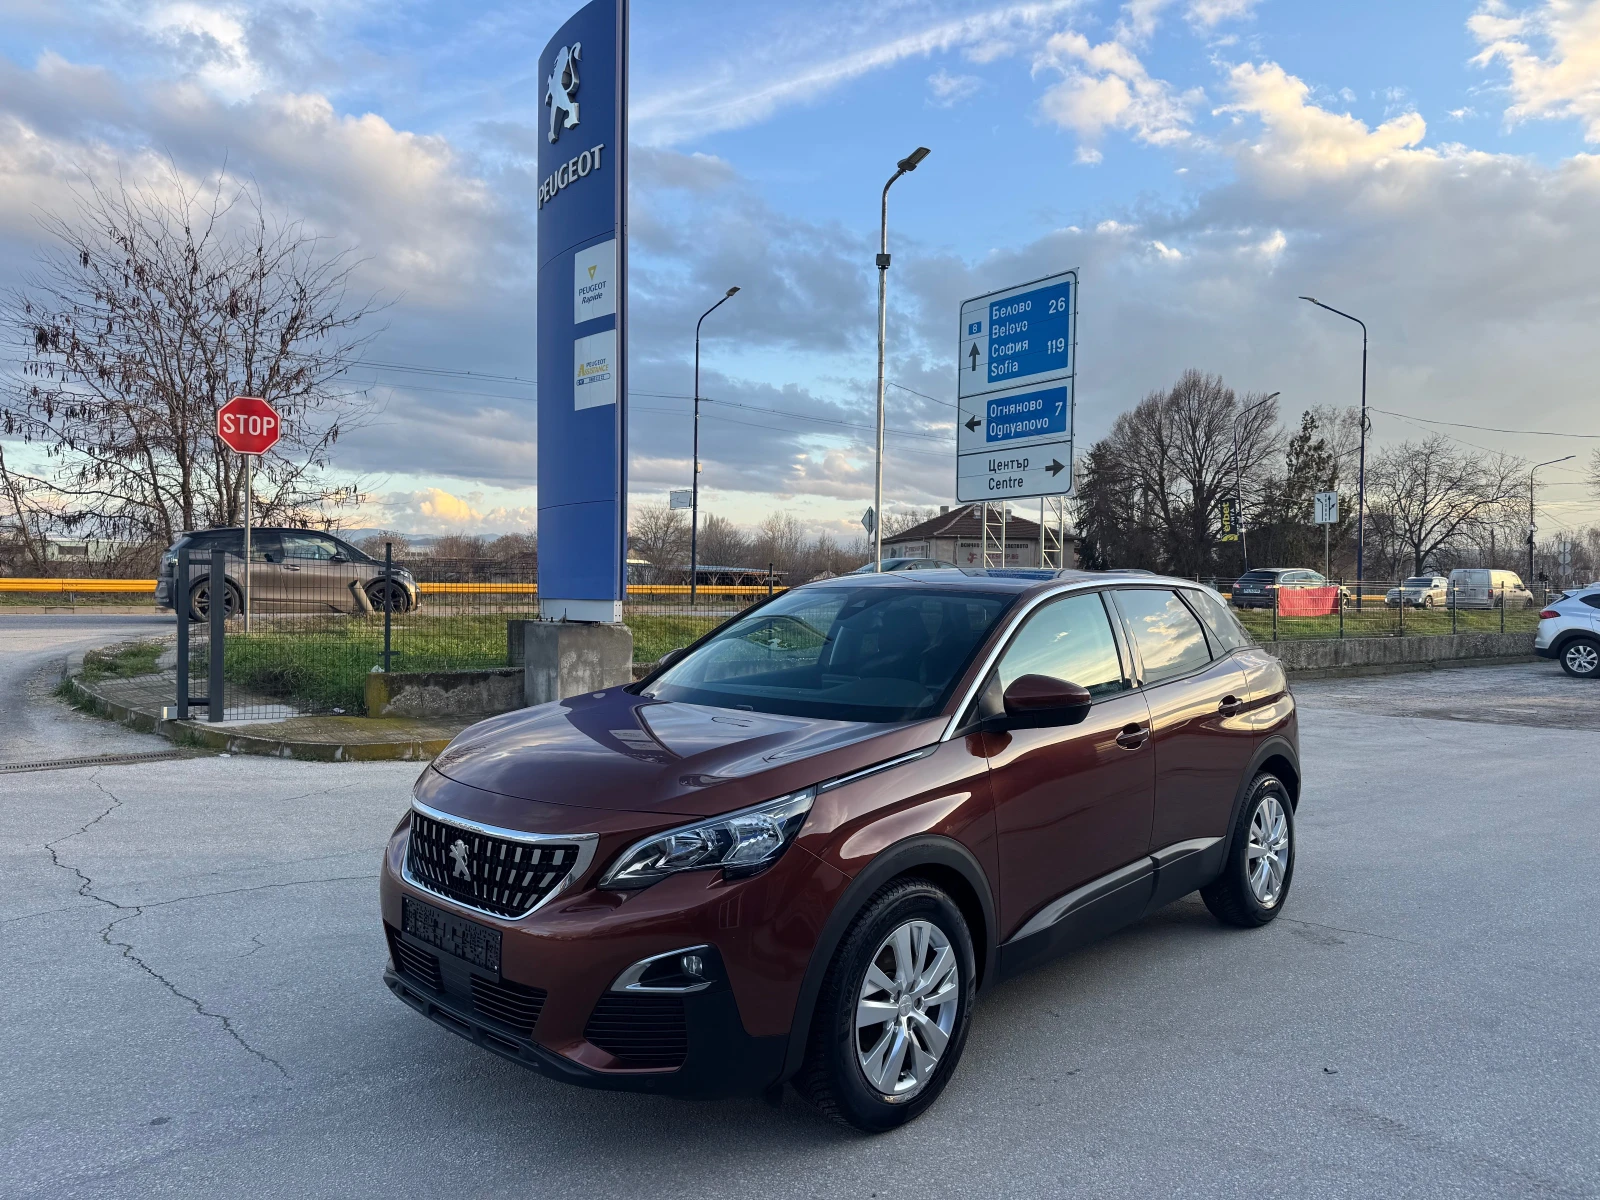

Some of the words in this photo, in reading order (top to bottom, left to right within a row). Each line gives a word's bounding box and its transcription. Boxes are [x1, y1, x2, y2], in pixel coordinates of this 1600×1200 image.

[538, 143, 605, 210] PEUGEOT
[578, 280, 607, 296] PEUGEOT
[581, 292, 603, 304] Rapide
[992, 300, 1032, 320] Белово
[1048, 297, 1066, 314] 26
[972, 323, 978, 333] 8
[992, 320, 1028, 339] Belovo
[991, 340, 1029, 358] София
[1047, 337, 1065, 354] 119
[585, 358, 606, 368] PEUGEOT
[991, 360, 1019, 376] Sofia
[990, 399, 1043, 418] Огняново
[1055, 401, 1063, 416] 7
[222, 413, 275, 437] STOP
[989, 417, 1049, 438] Ognyanovo
[988, 458, 1029, 474] Център
[988, 476, 1024, 491] Centre
